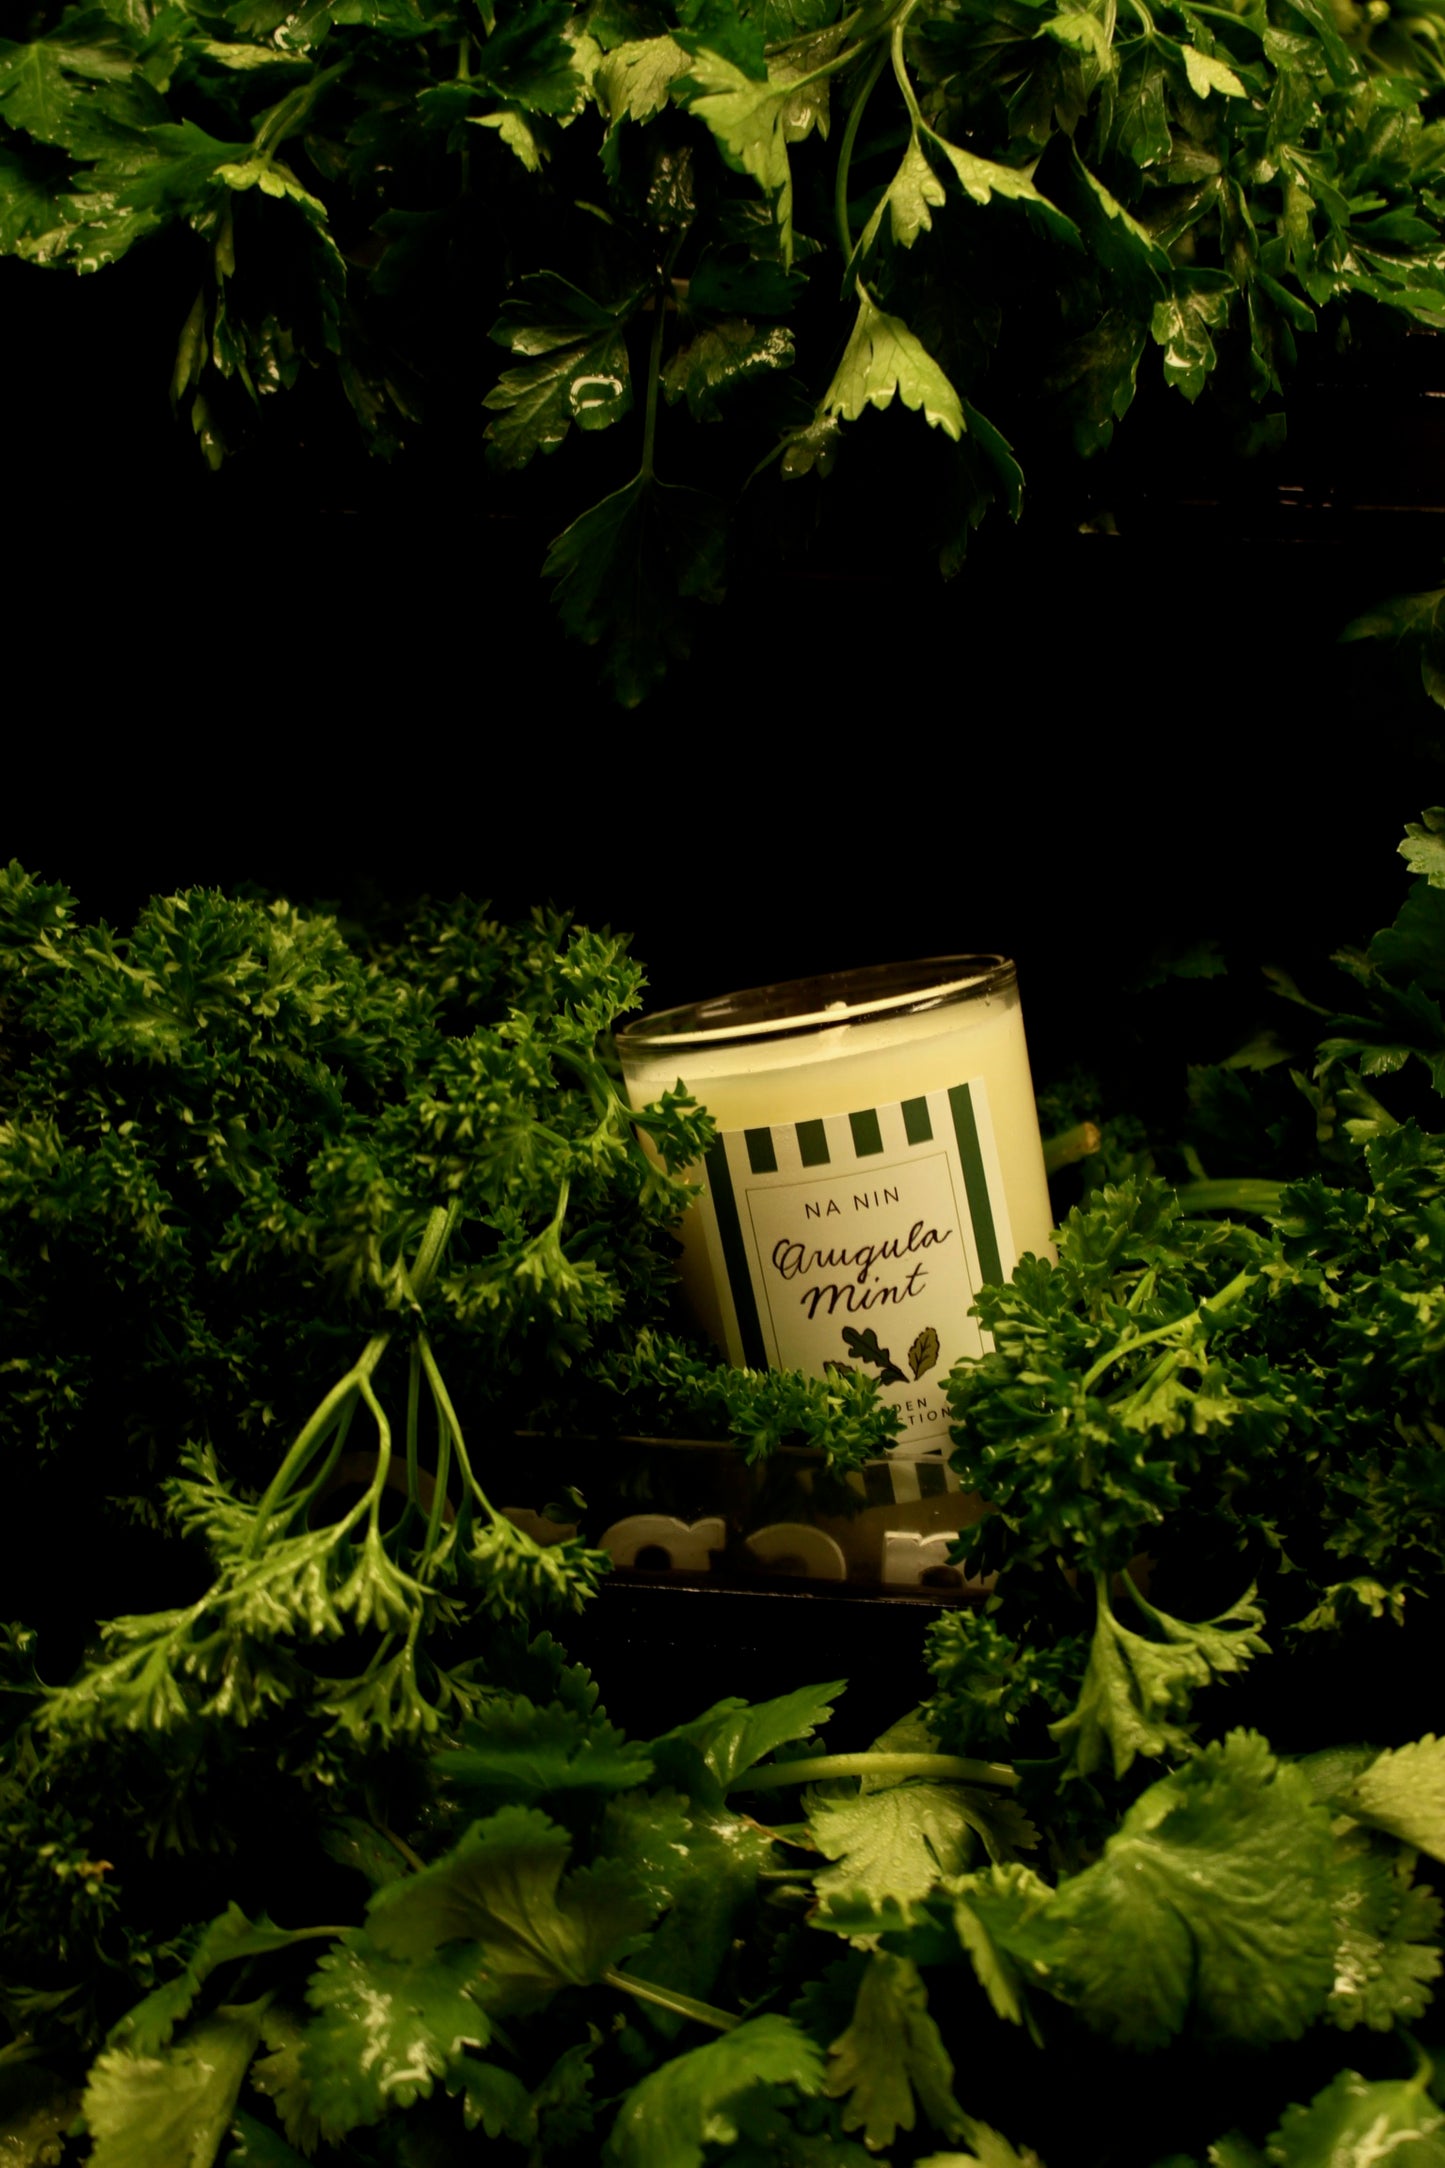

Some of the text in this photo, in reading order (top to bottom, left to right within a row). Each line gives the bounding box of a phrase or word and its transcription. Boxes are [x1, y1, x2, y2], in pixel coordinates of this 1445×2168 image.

[805, 1186, 899, 1219] NA NIN
[882, 1397, 927, 1414] DEN
[899, 1406, 952, 1425] TION
